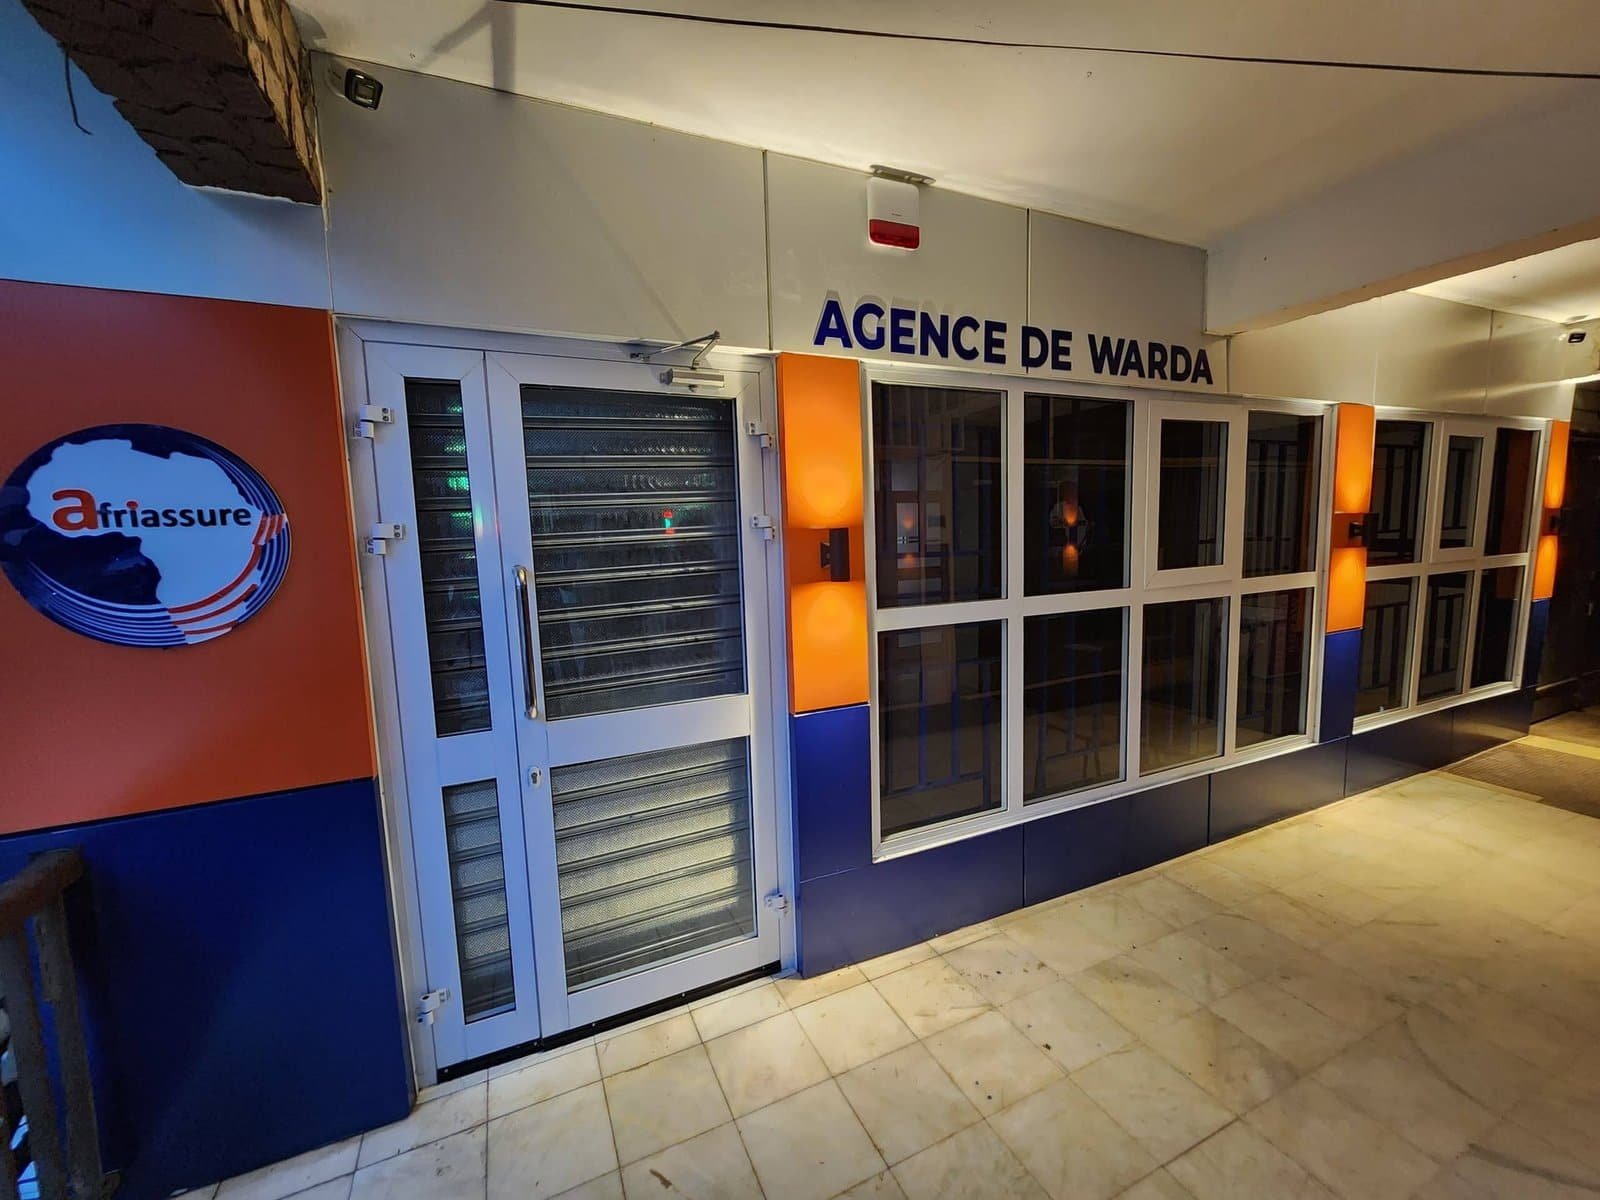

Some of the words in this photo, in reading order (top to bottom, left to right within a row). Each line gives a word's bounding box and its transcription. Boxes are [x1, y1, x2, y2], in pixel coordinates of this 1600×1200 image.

[813, 300, 1007, 365] AGENCE
[1021, 326, 1073, 371] DE
[1088, 334, 1213, 385] WARDA
[52, 489, 251, 531] afriassure
